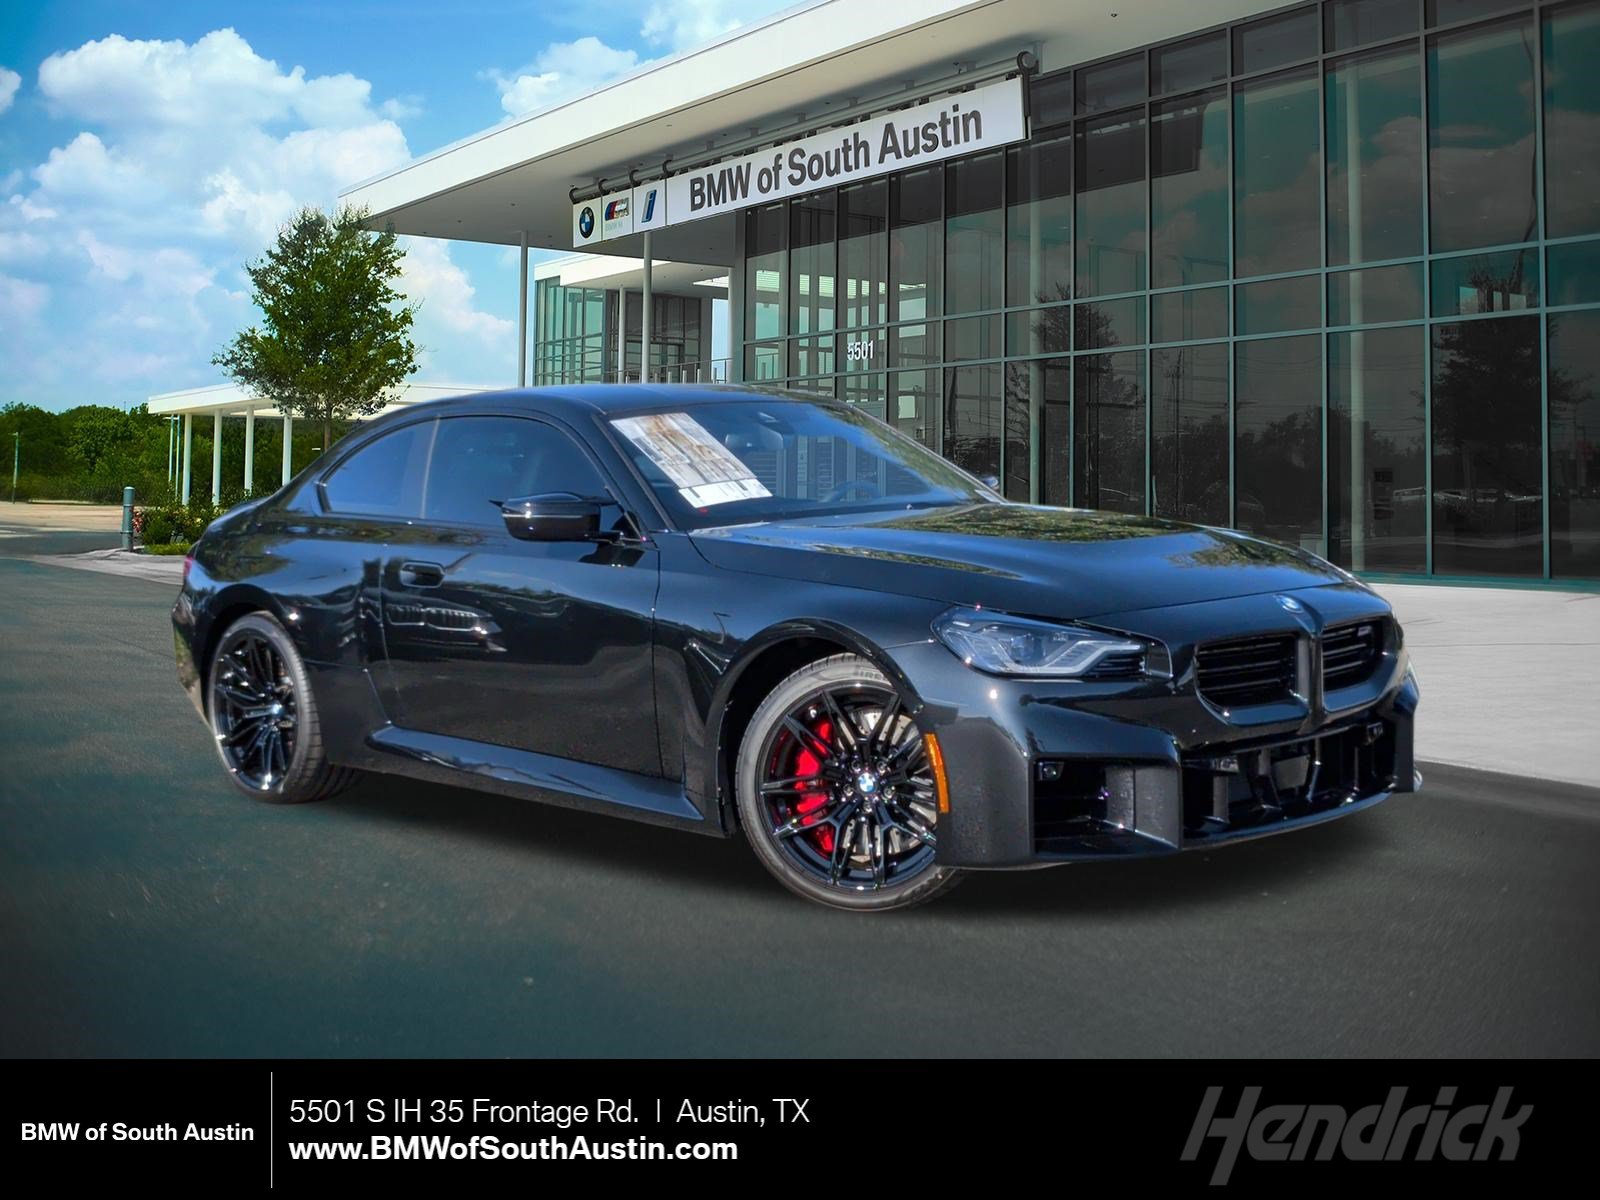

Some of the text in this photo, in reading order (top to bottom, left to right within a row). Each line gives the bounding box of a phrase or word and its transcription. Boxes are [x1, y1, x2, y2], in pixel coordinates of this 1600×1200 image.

[690, 105, 983, 212] BMW of South Austin
[847, 340, 874, 361] 5501
